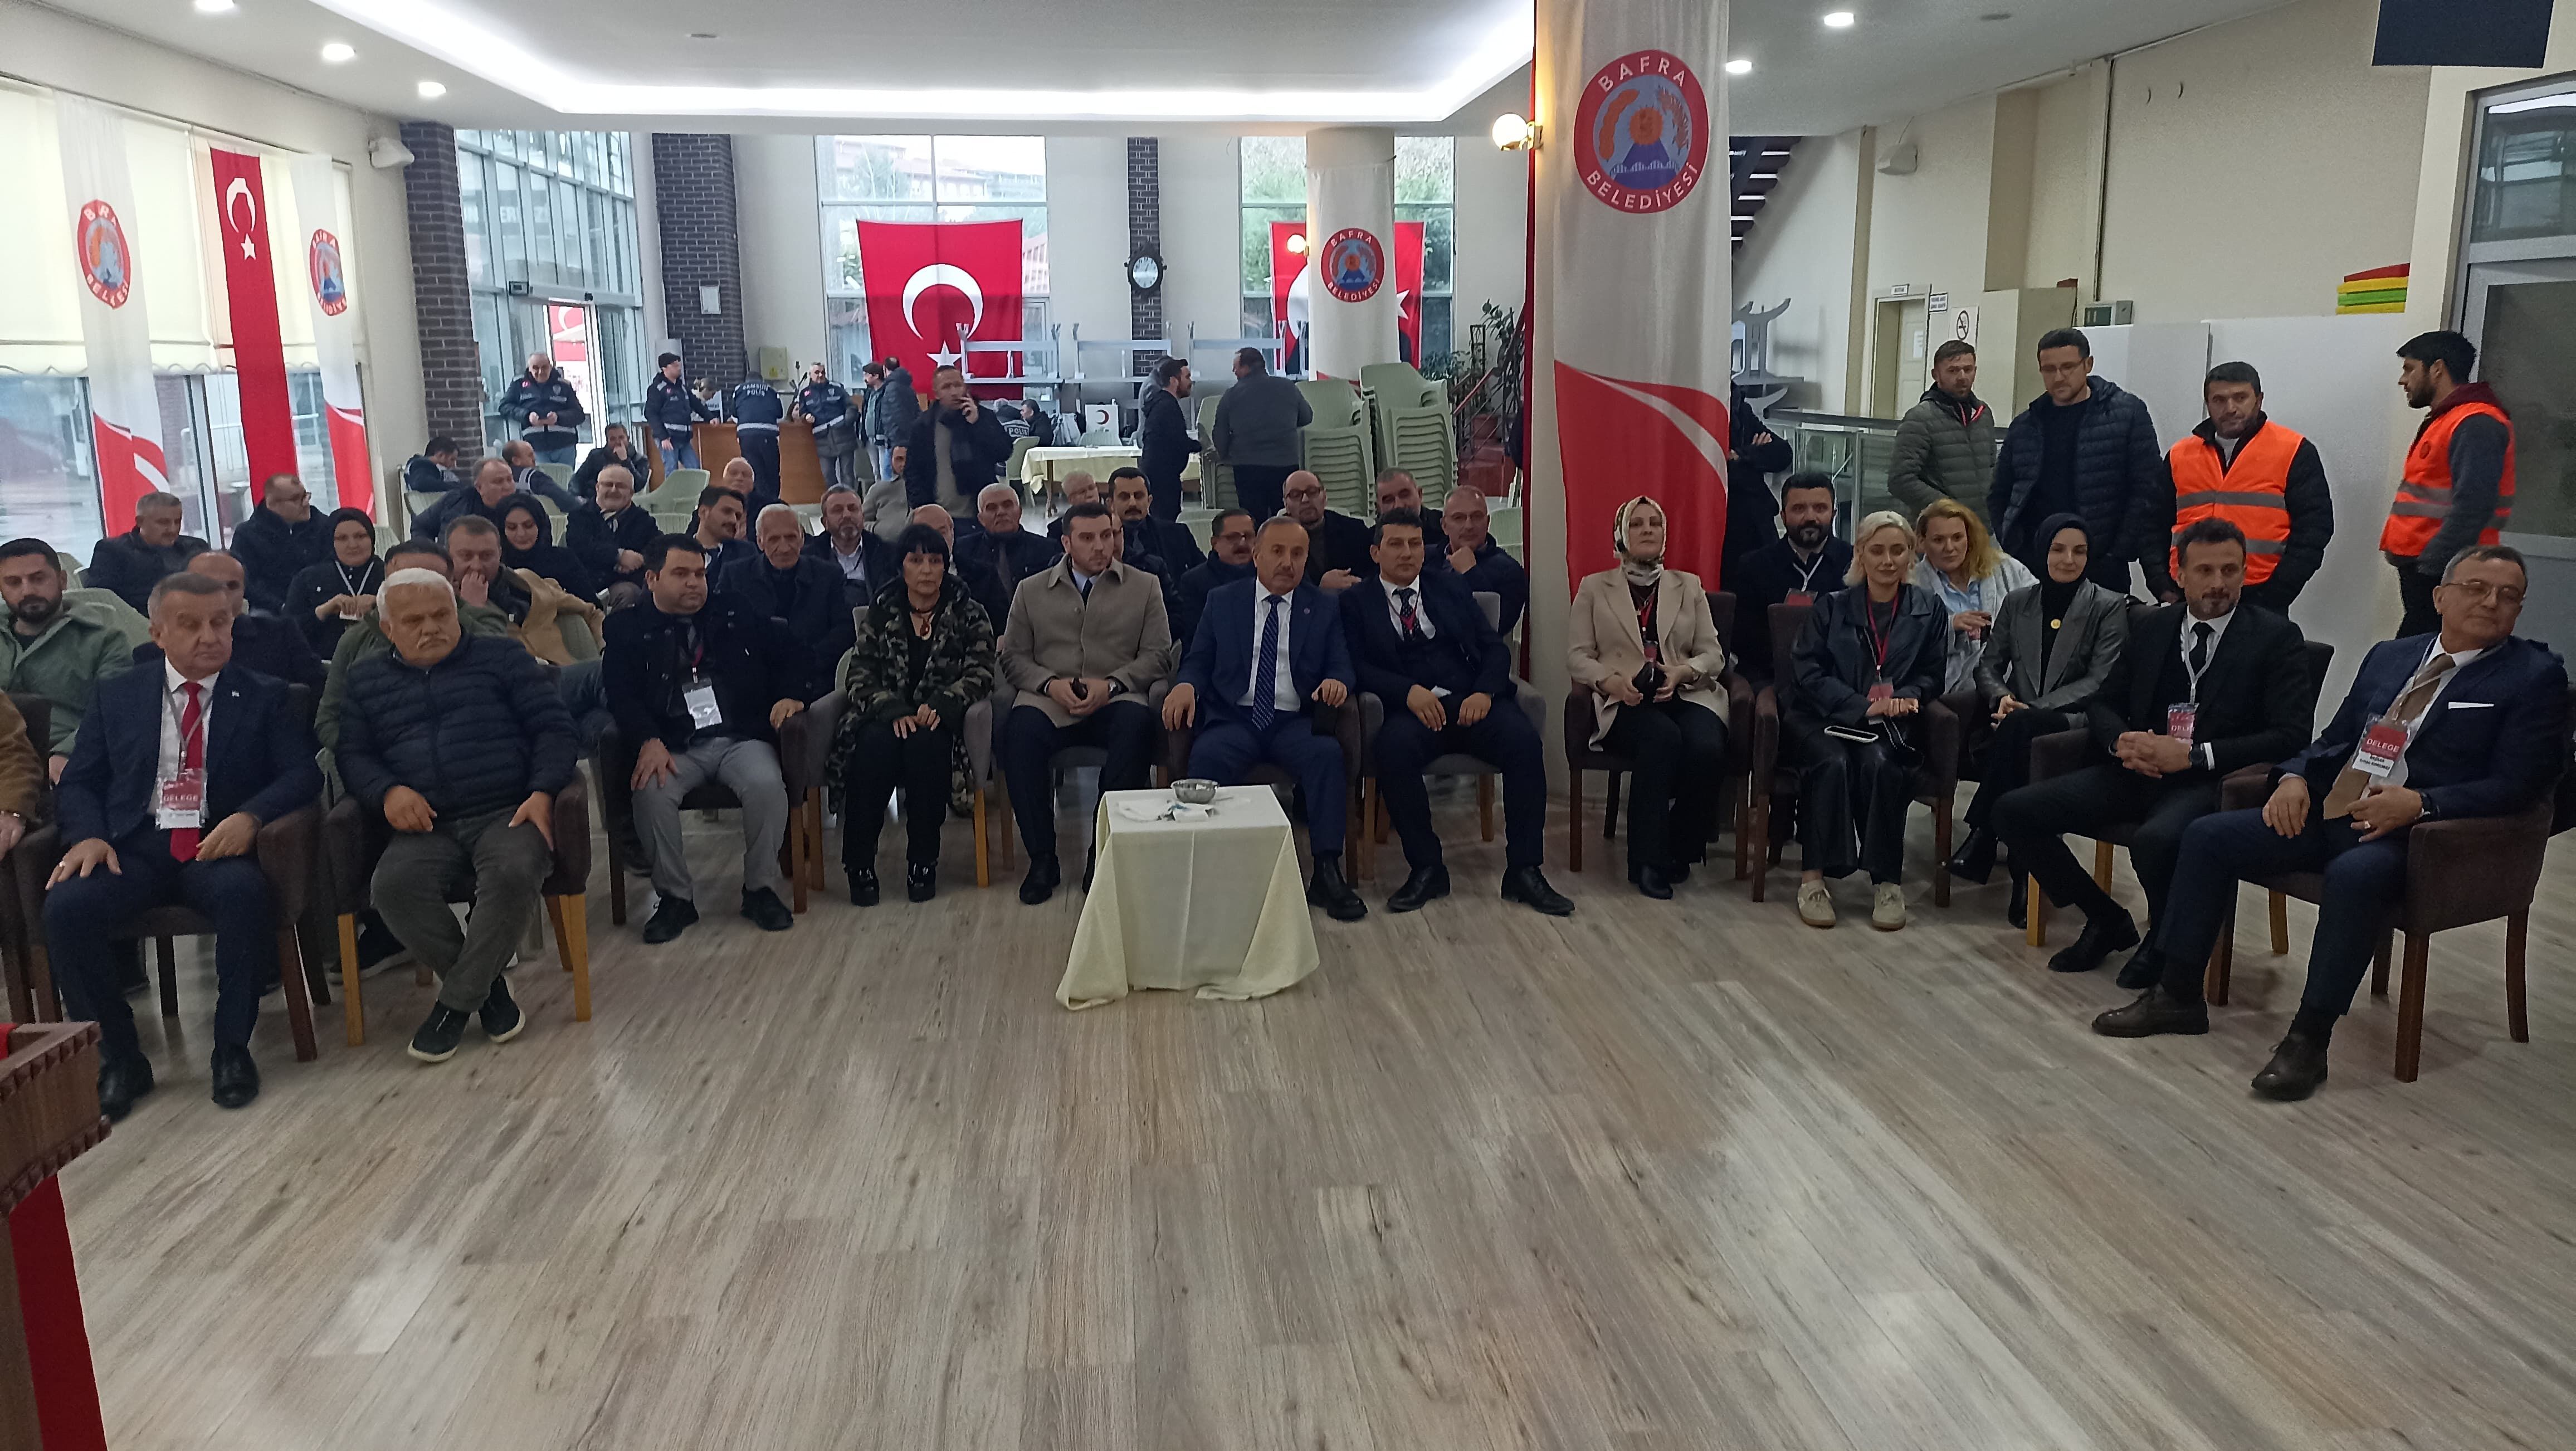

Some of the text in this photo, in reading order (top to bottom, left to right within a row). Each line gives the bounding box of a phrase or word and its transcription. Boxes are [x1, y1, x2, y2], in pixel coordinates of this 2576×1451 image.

[1598, 56, 1685, 92] BAFRA
[1587, 161, 1698, 210] BELEDİYESİ
[1330, 230, 1372, 247] BAFRA
[1327, 279, 1380, 301] BELEDİYESİ
[2366, 738, 2401, 753] DELEGE
